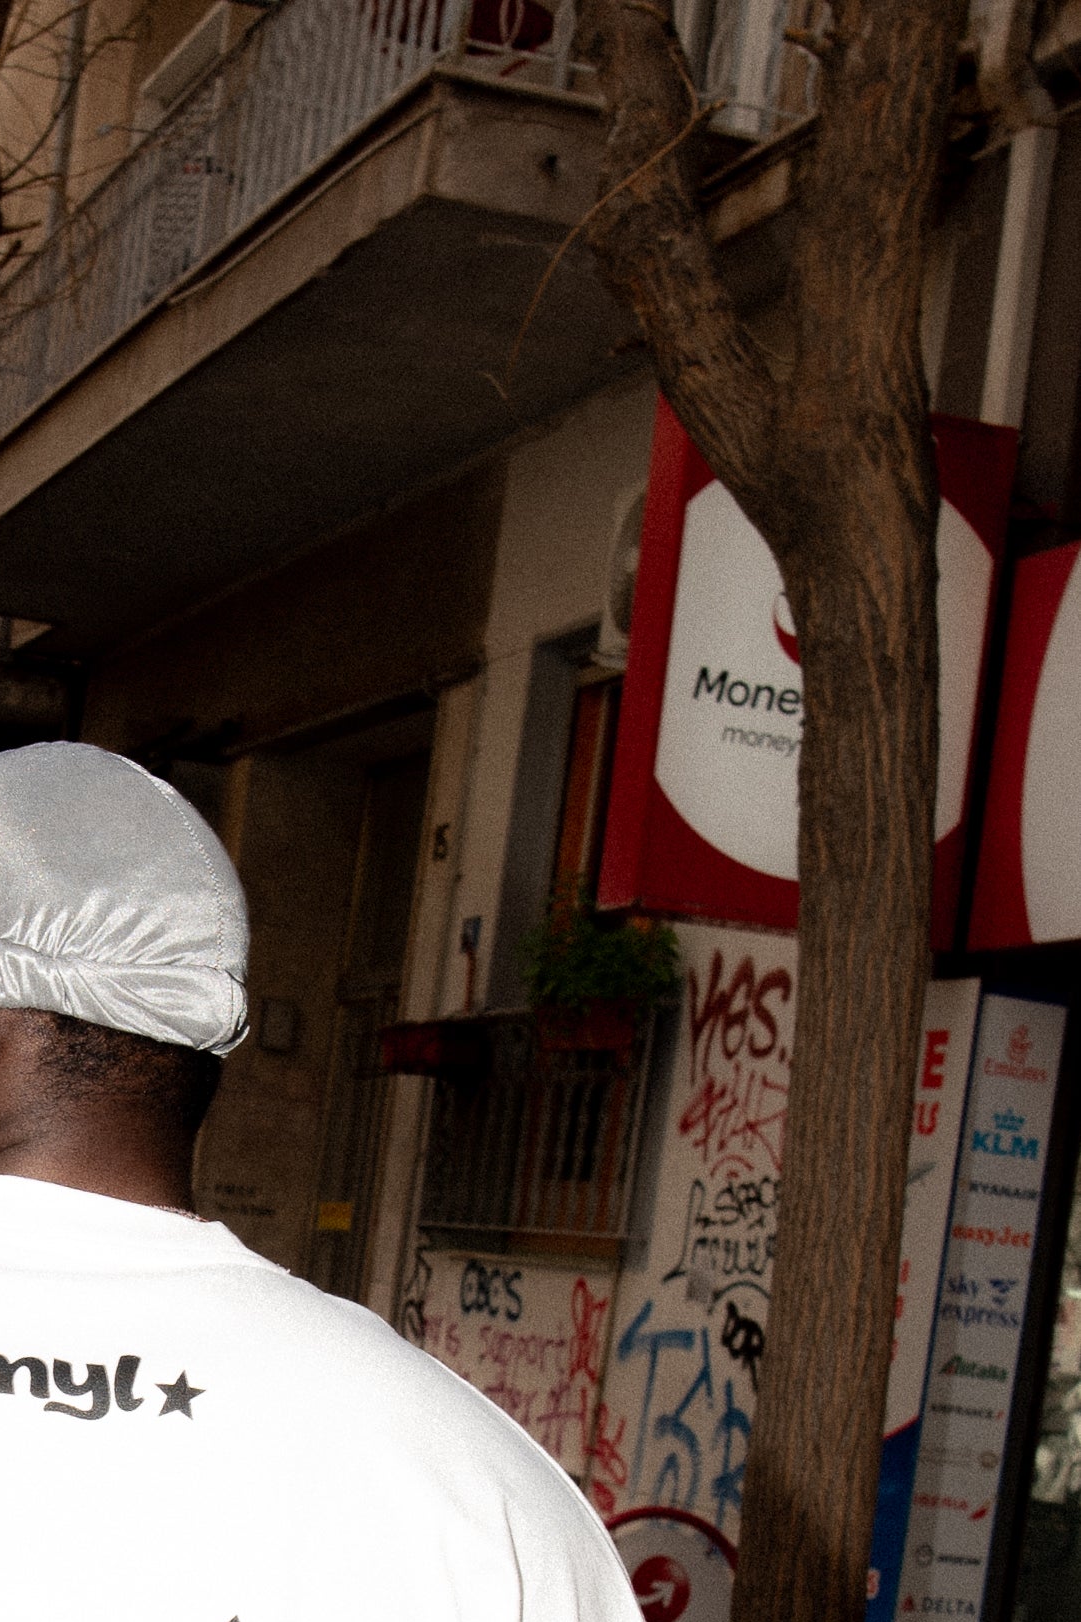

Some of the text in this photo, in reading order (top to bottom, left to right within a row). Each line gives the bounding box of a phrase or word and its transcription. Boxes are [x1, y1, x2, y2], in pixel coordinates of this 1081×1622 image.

[692, 667, 806, 727] Mone
[971, 1130, 1039, 1161] KLM
[951, 1223, 1032, 1248] easyJet
[946, 1274, 979, 1299] sky
[940, 1302, 1020, 1328] express
[921, 1596, 976, 1616] DELTA
